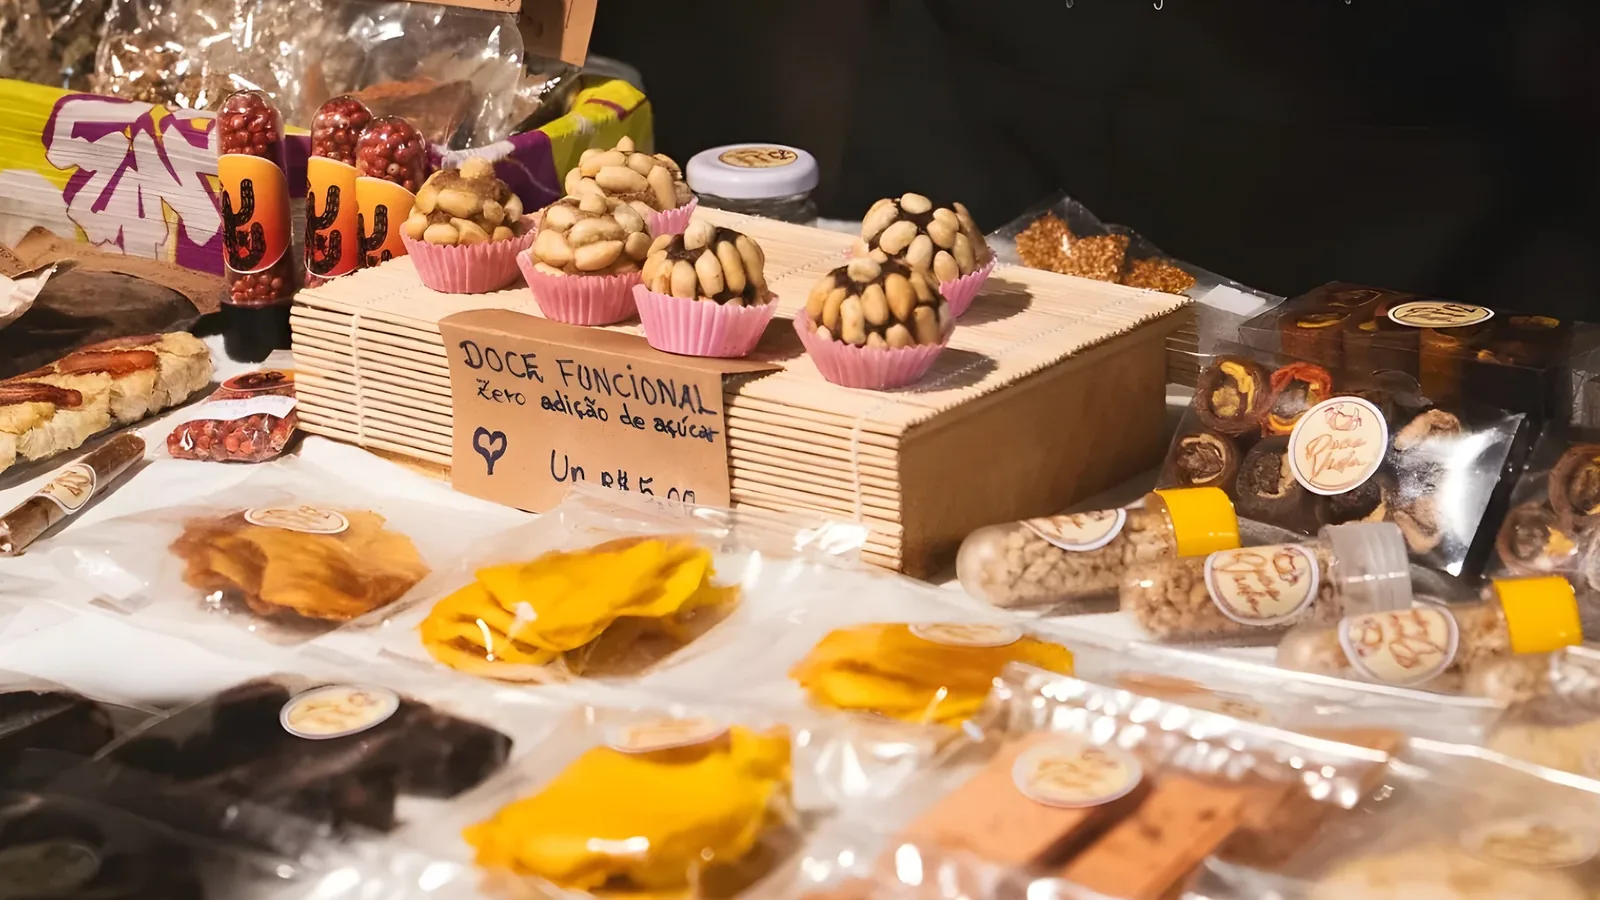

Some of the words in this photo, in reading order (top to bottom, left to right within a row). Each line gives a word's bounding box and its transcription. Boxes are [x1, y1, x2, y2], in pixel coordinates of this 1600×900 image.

[459, 340, 544, 383] DOCE
[476, 378, 526, 406] Zero
[541, 389, 609, 422] adição
[620, 402, 645, 430] de
[653, 416, 720, 443] açúcar
[550, 449, 585, 482] Un
